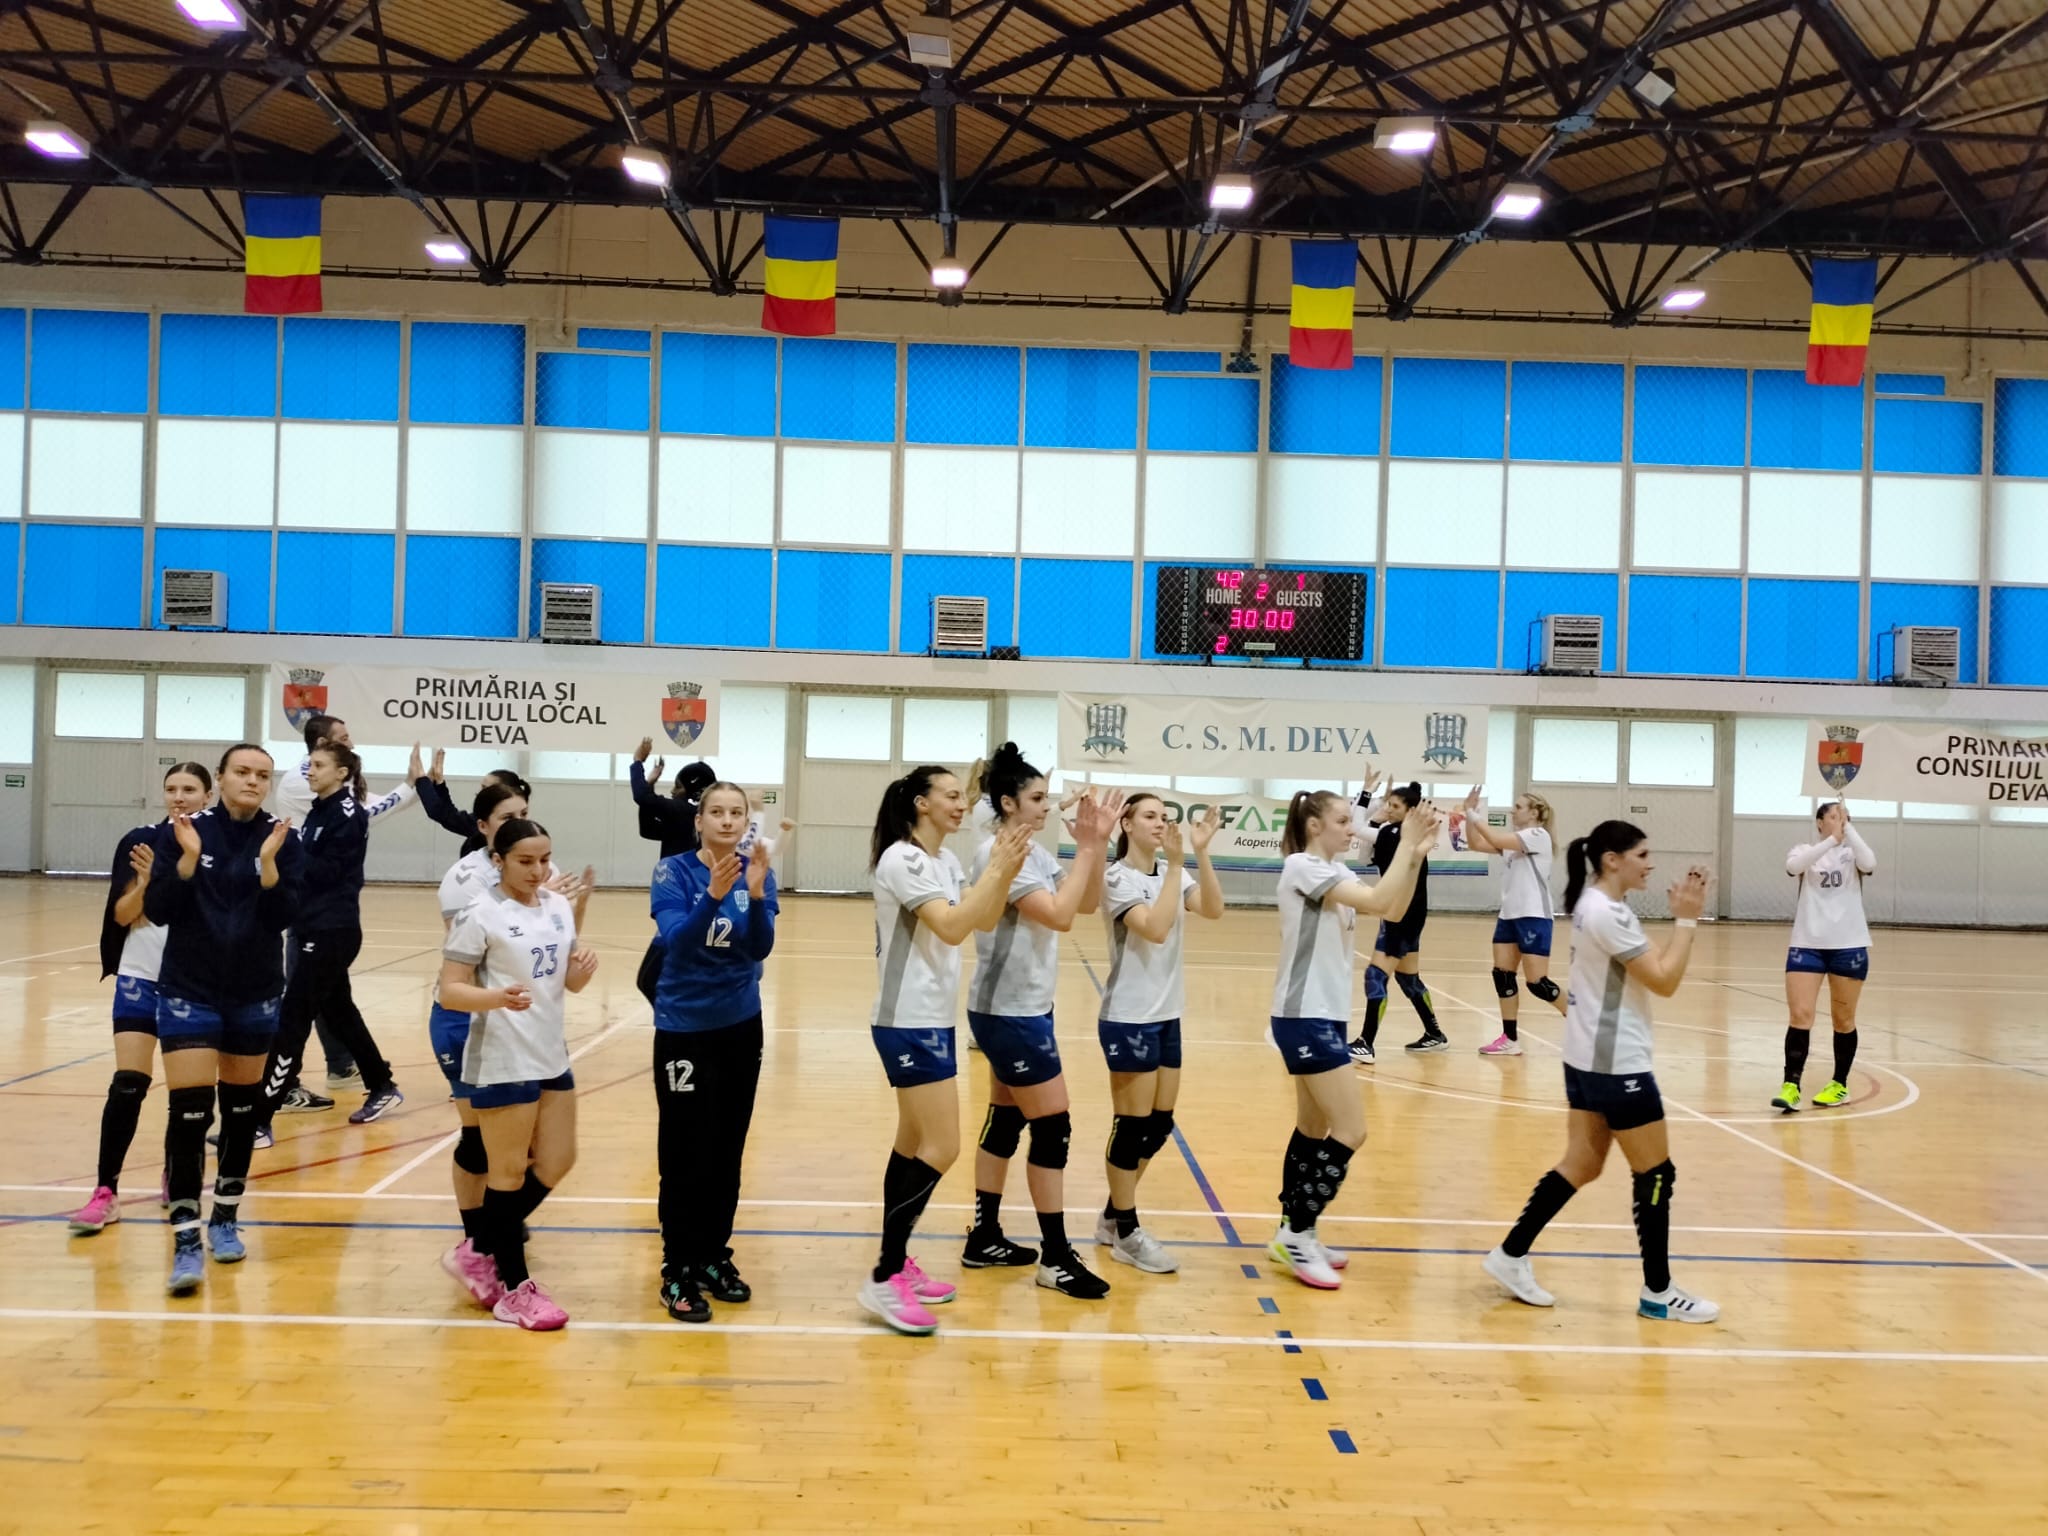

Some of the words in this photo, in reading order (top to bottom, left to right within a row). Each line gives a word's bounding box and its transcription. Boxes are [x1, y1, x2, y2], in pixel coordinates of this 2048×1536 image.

[1217, 571, 1242, 589] 42
[1206, 588, 1242, 605] HOME
[1256, 582, 1269, 600] 2
[1276, 590, 1323, 608] GUESTS
[1215, 635, 1228, 653] 2
[415, 674, 546, 700] PRIMĂRIA
[383, 699, 518, 721] CONSILIUL
[526, 703, 608, 725] LOCAL
[460, 724, 530, 745] DEVA
[1162, 723, 1193, 750] C.
[1203, 725, 1228, 751] S.
[1239, 727, 1276, 752] M.
[1287, 726, 1381, 755] DEVA
[1917, 757, 2043, 779] CONSILIUL
[1820, 871, 1843, 888] 20
[705, 917, 732, 948] 12
[530, 943, 558, 979] 23
[666, 1060, 696, 1092] 12
